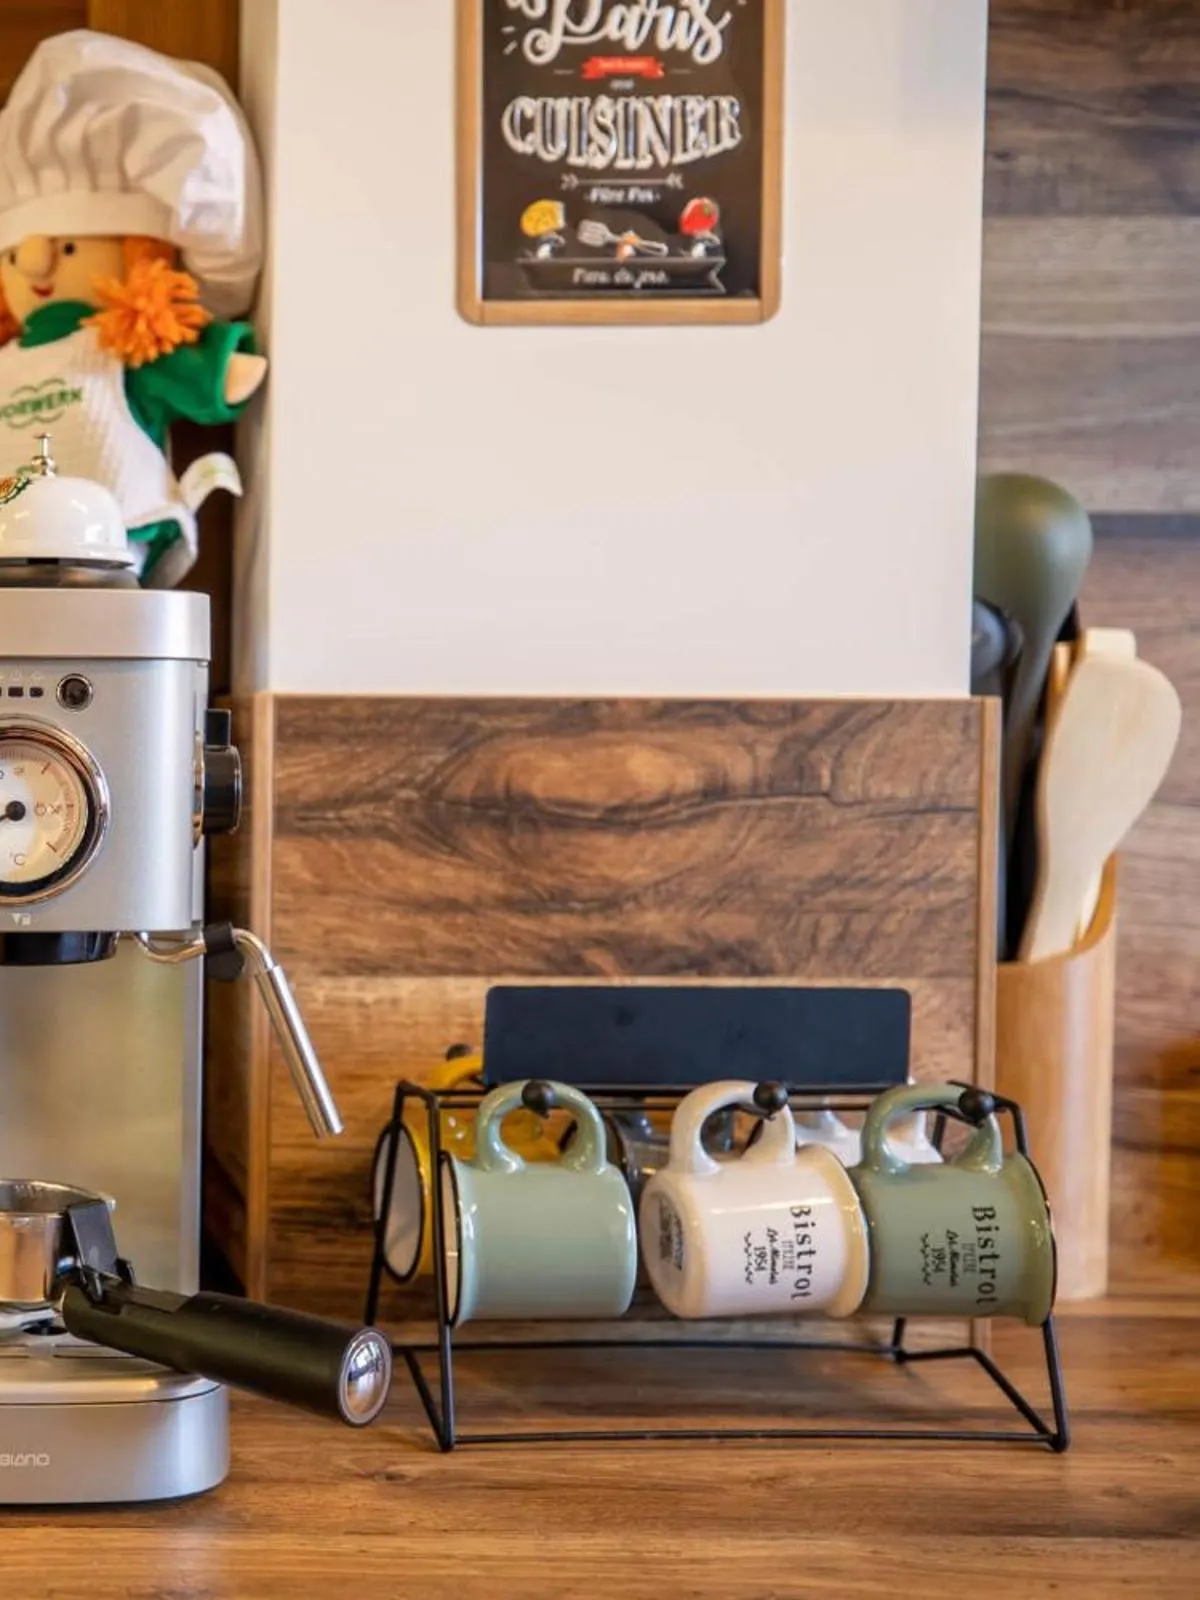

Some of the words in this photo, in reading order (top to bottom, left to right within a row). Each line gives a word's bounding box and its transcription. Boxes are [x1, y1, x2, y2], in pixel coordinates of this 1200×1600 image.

[502, 95, 742, 170] CUISINER
[753, 1246, 766, 1272] 1954
[790, 1205, 817, 1300] Bistrot
[971, 1205, 1001, 1304] Bistrot
